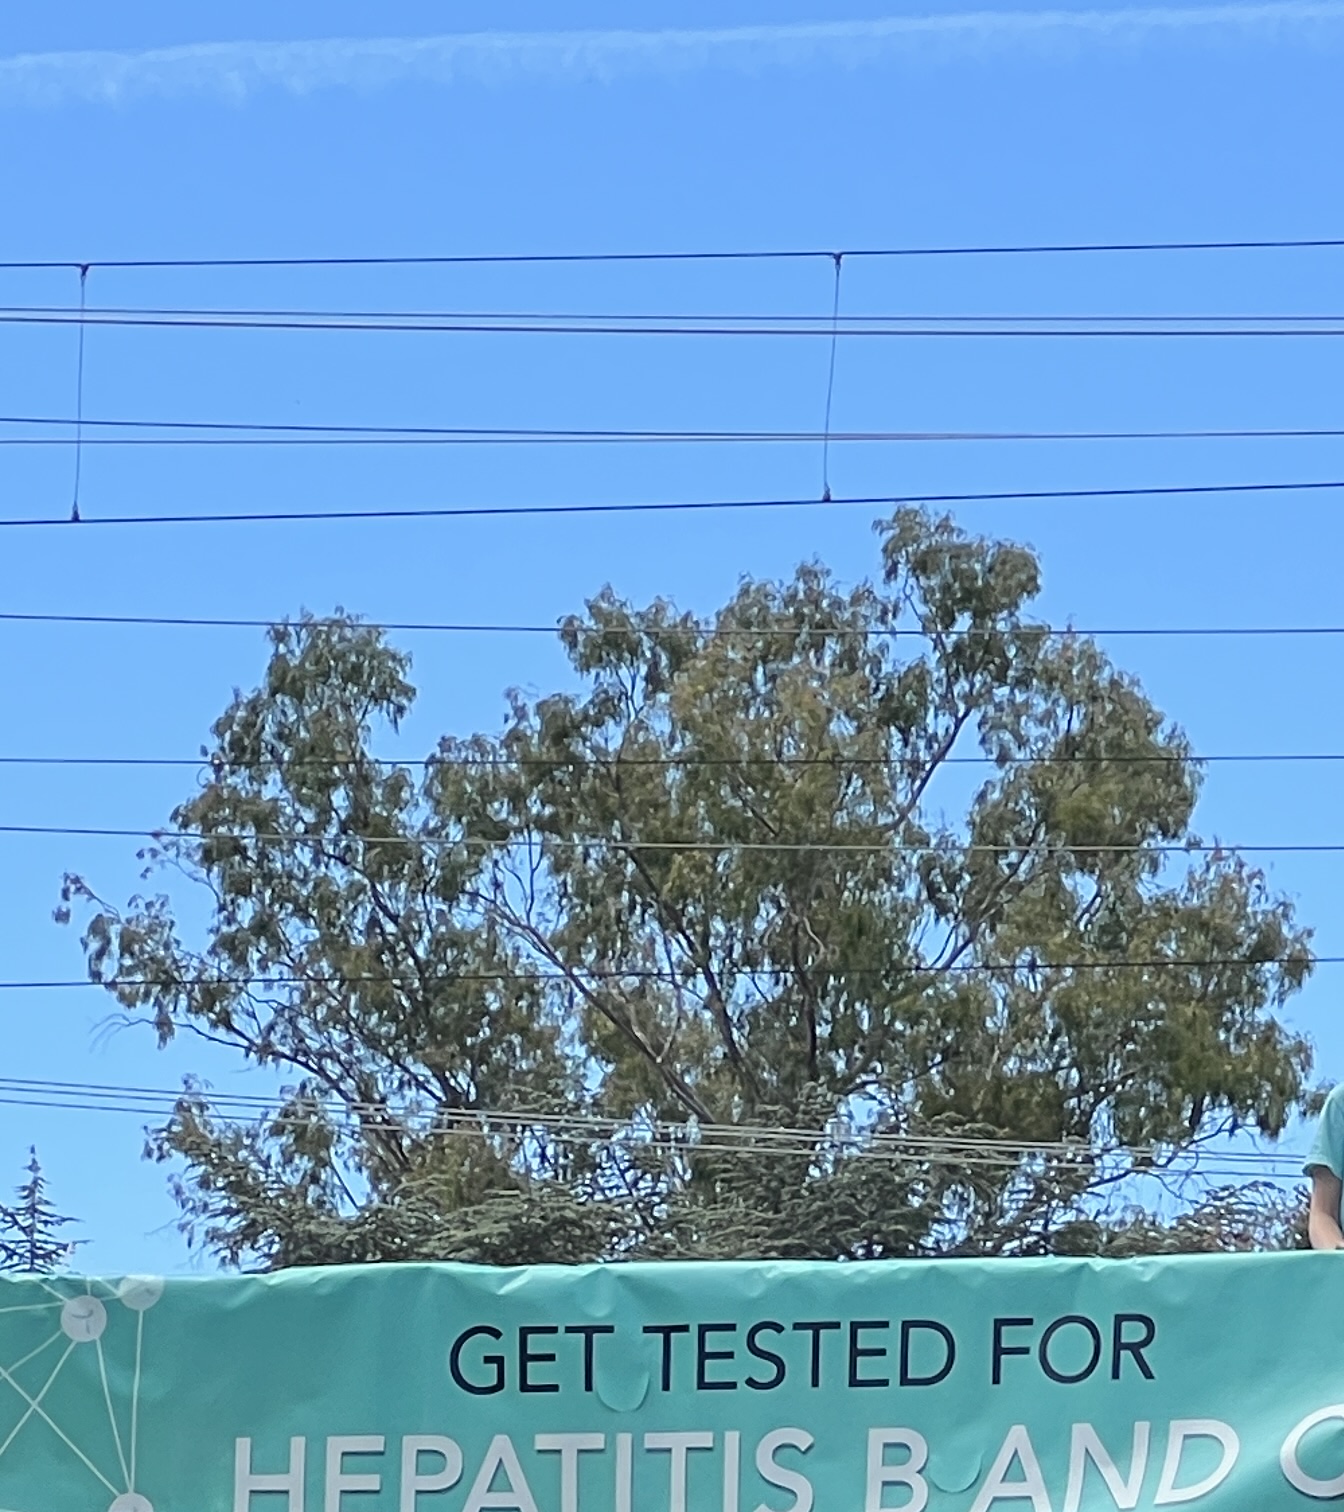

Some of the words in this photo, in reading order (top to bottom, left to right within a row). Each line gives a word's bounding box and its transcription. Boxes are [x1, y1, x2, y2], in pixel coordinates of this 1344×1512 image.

[449, 1324, 615, 1396] GET
[642, 1318, 957, 1392] TESTED
[991, 1313, 1157, 1387] FOR
